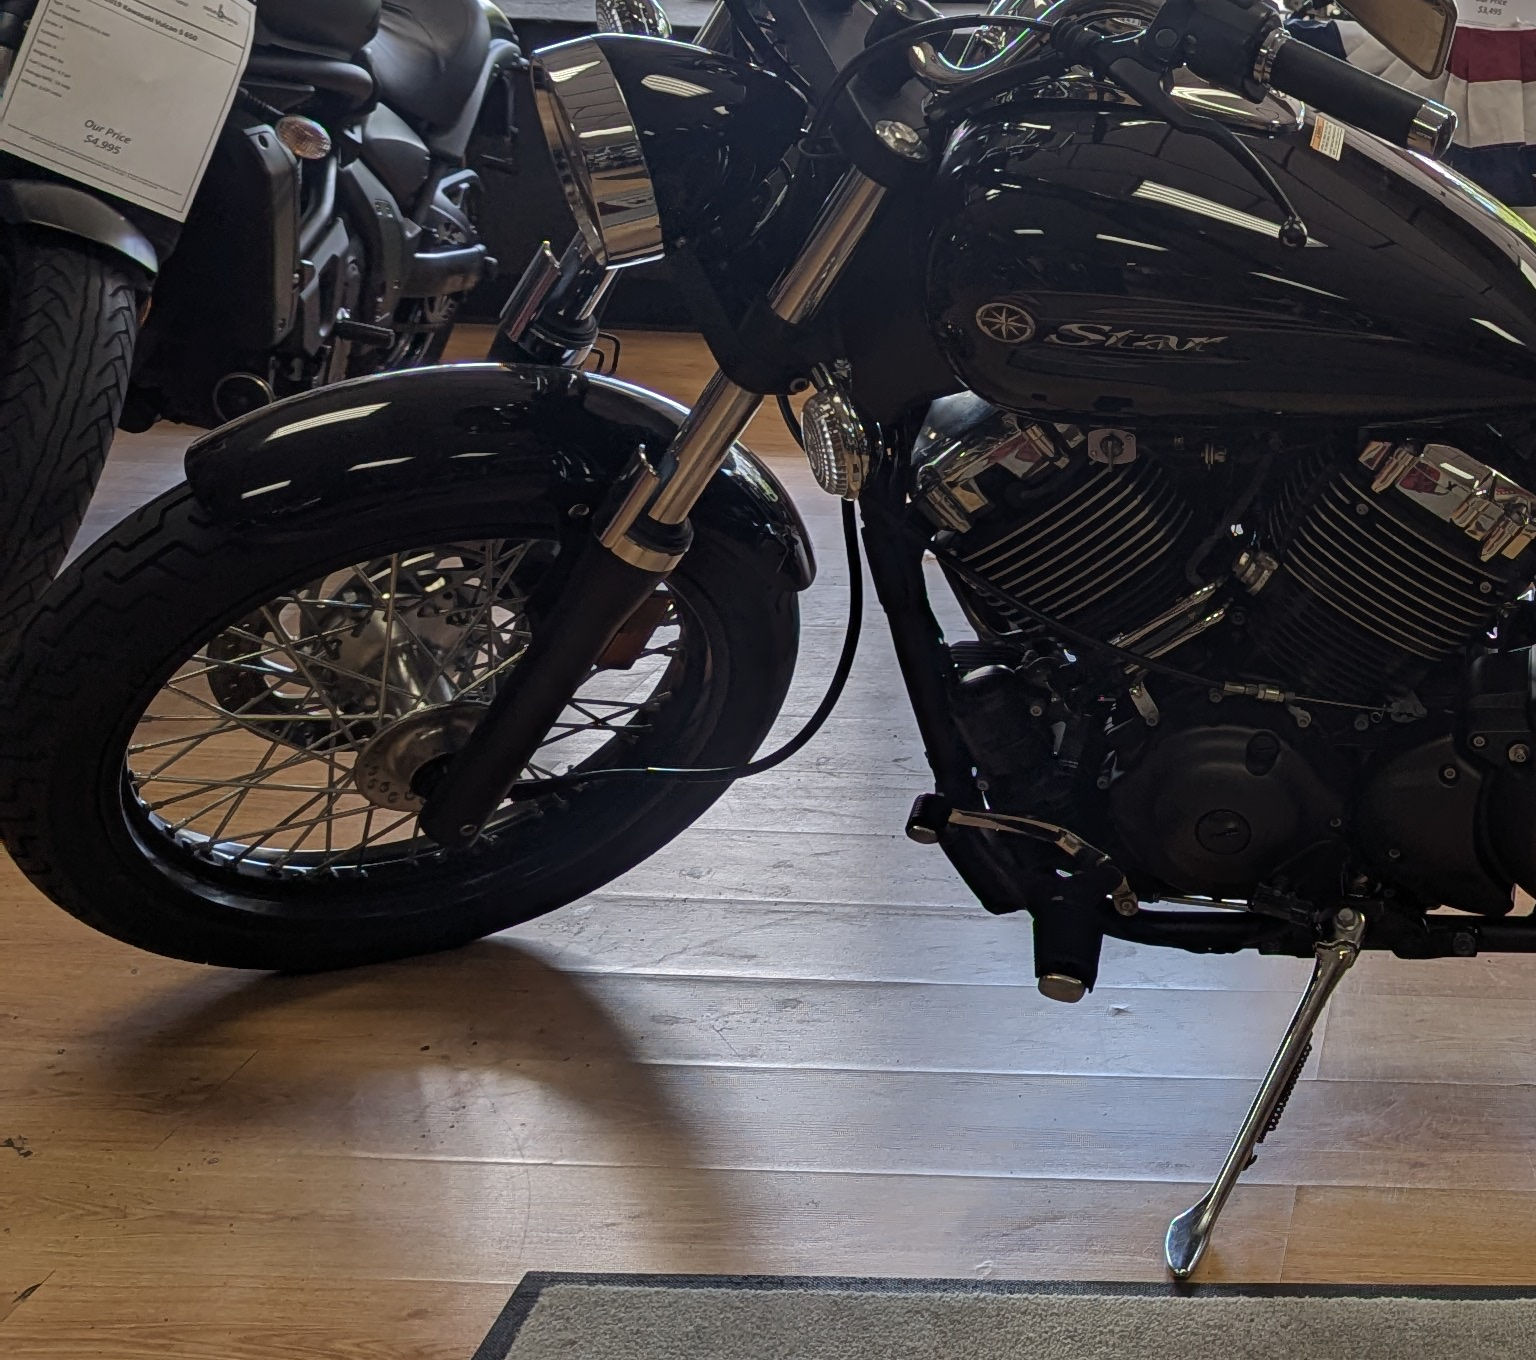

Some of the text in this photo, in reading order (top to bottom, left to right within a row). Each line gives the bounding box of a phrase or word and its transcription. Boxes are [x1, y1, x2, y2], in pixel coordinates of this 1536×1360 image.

[1477, 5, 1503, 17] $3,495
[85, 118, 132, 145] Our Price
[83, 133, 122, 155] $4,995
[1044, 322, 1230, 353] Star
